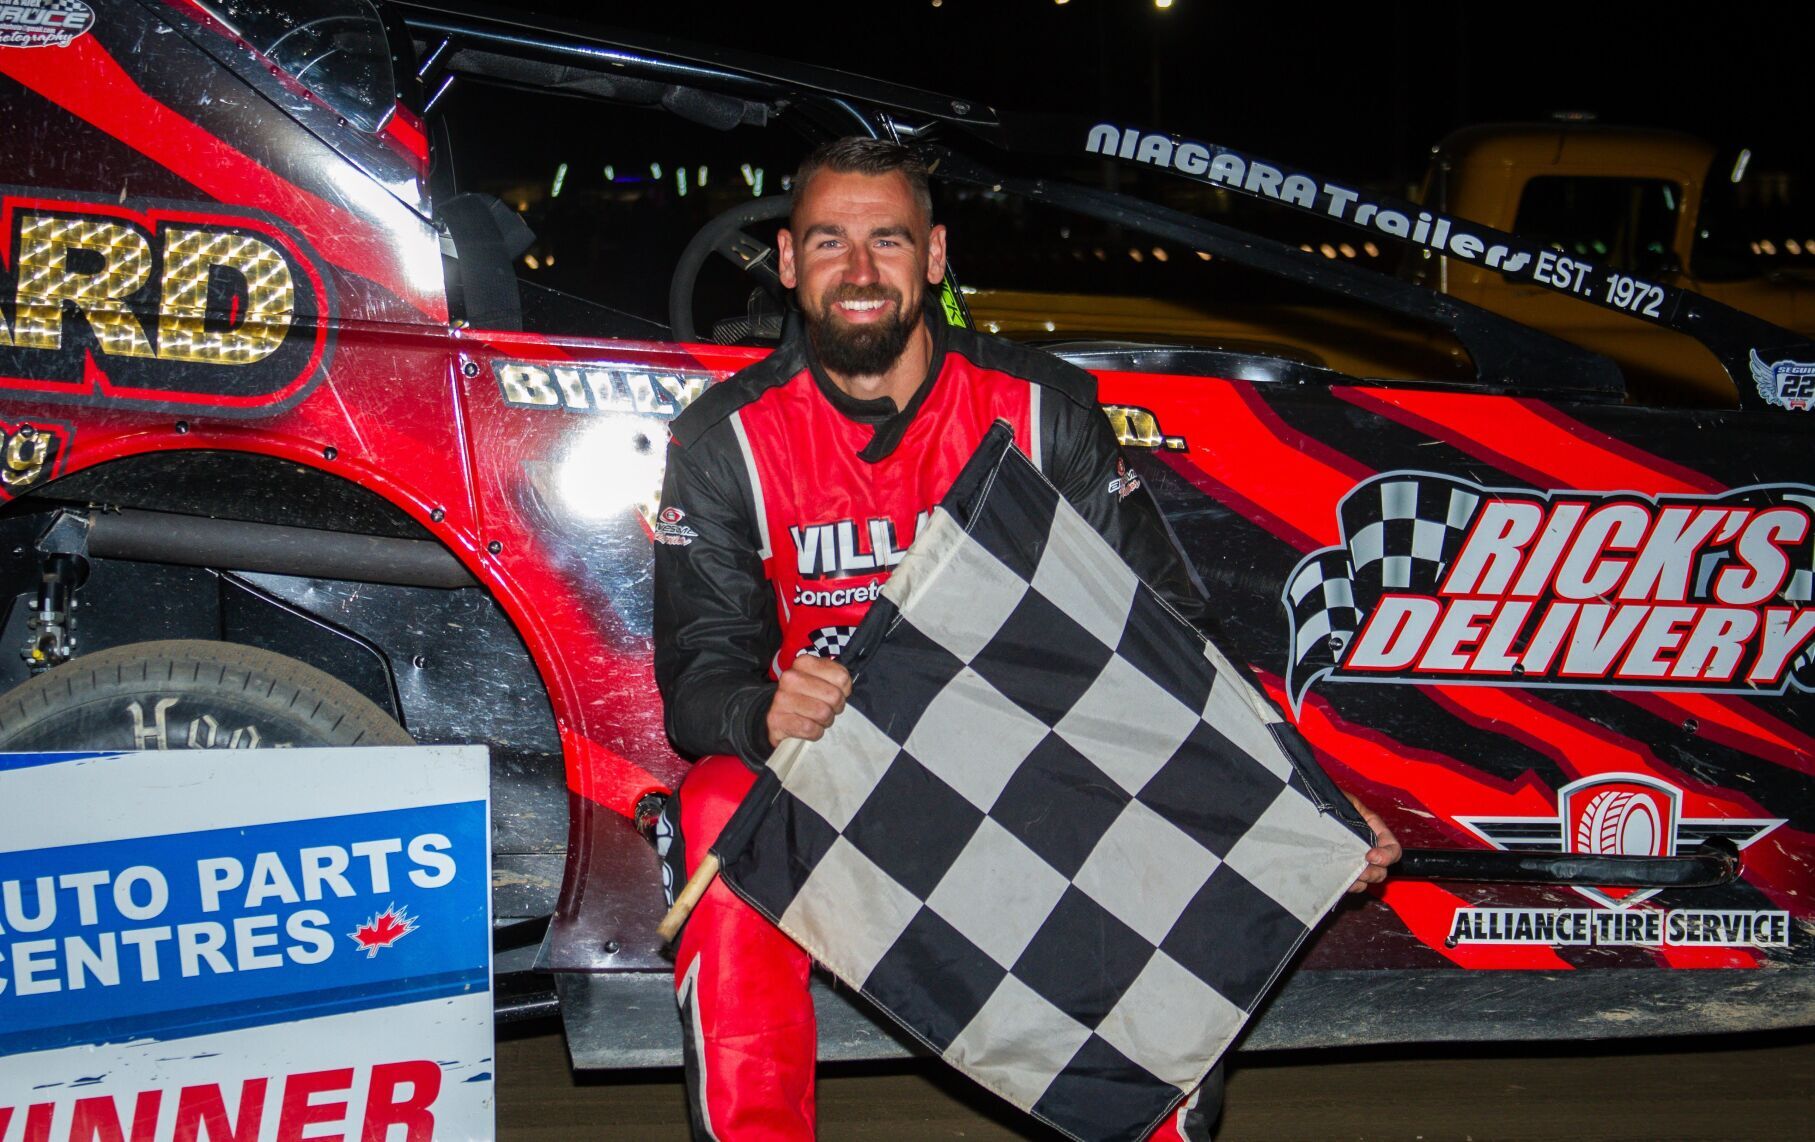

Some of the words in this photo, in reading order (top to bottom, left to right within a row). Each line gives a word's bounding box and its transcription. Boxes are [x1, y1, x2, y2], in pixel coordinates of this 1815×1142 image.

[0, 5, 90, 29] RUCE
[0, 30, 73, 47] otography
[1085, 124, 1318, 209] NIAGARA
[1323, 183, 1531, 272] Trailers
[1533, 250, 1593, 297] EST.
[1605, 273, 1665, 318] 1972
[0, 216, 294, 364] RD
[500, 364, 708, 415] BILLY
[1780, 375, 1815, 398] 22
[0, 430, 50, 485] g
[1442, 501, 1808, 605] RICK'S
[1347, 596, 1815, 680] DELIVERY
[127, 698, 293, 750] Hoo
[197, 833, 457, 913] PARTS
[1456, 912, 1588, 941] ALLIANCE
[1595, 912, 1660, 942] TIRE
[1667, 912, 1789, 944] SERVICE
